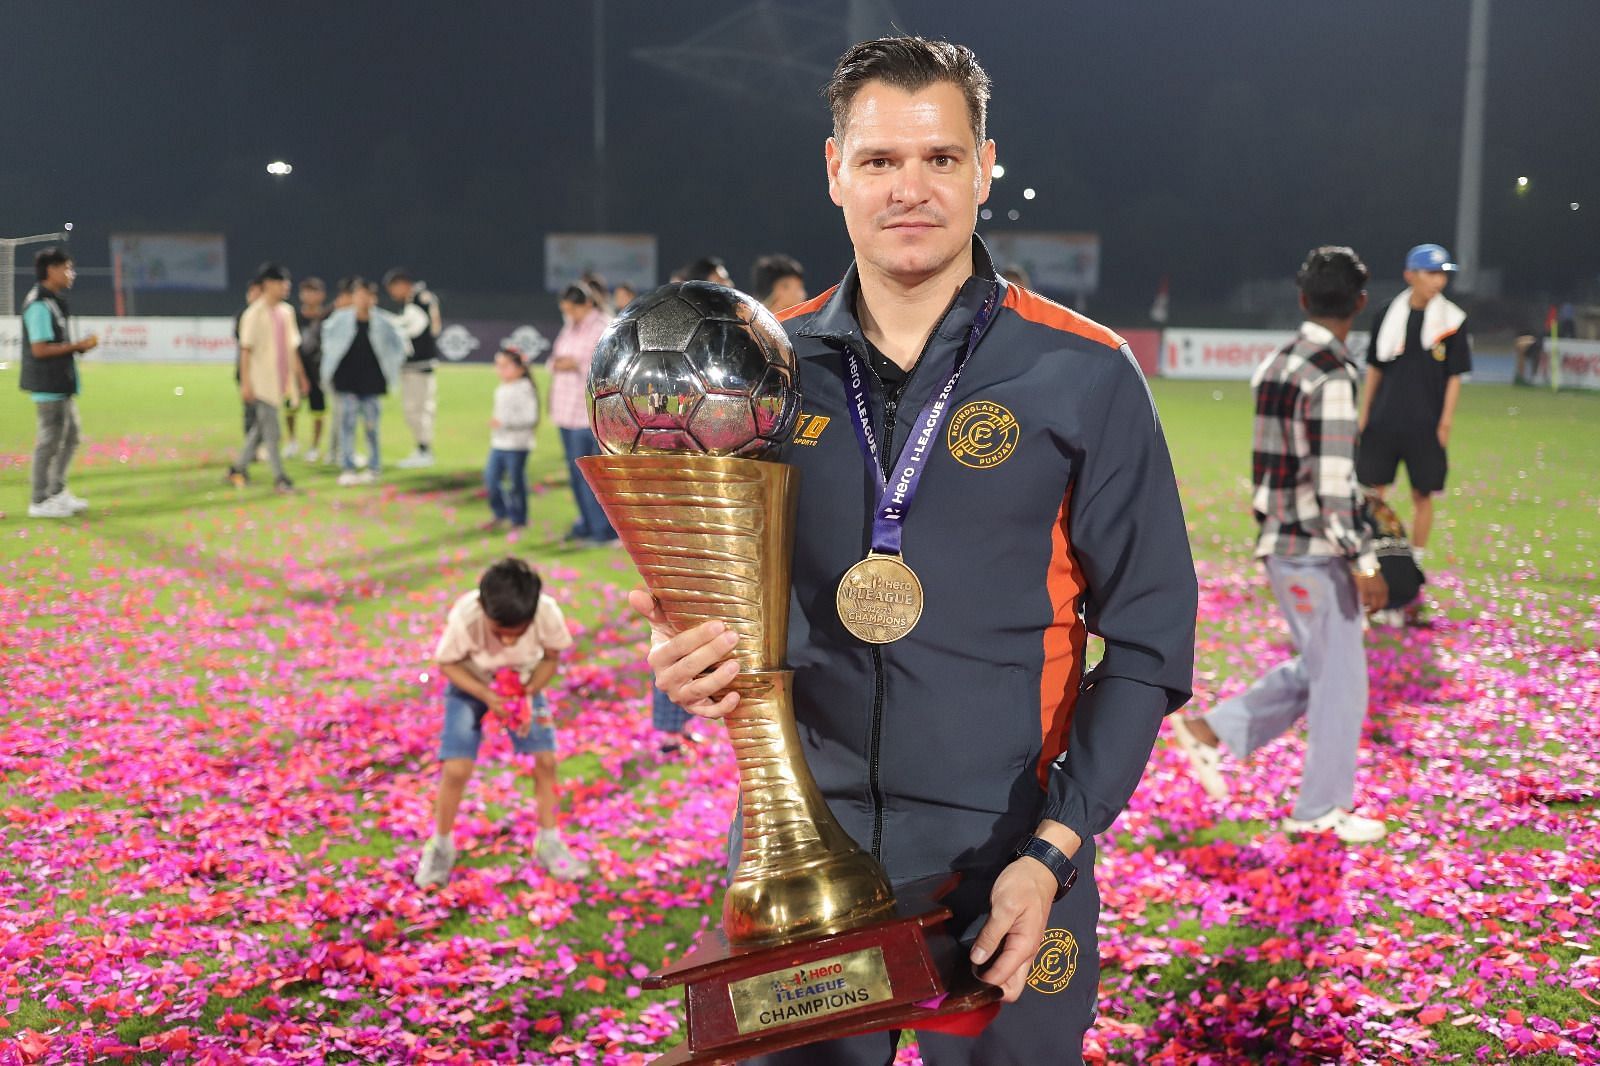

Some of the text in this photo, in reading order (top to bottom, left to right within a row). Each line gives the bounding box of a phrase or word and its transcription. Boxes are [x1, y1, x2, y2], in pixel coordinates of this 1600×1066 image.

[848, 354, 861, 389] Hero
[855, 392, 877, 454] I-LEAGUE
[951, 404, 1000, 437] ROUNDGLASS
[793, 437, 818, 447] SPORTS
[891, 467, 915, 504] Hero
[911, 401, 945, 462] I-LEAGUE
[979, 442, 1012, 465] PUNJAB
[885, 580, 913, 592] Hero
[848, 612, 907, 626] CHAMPIONS
[809, 963, 843, 980] Hero
[759, 988, 869, 1025] CHAMPIONS
